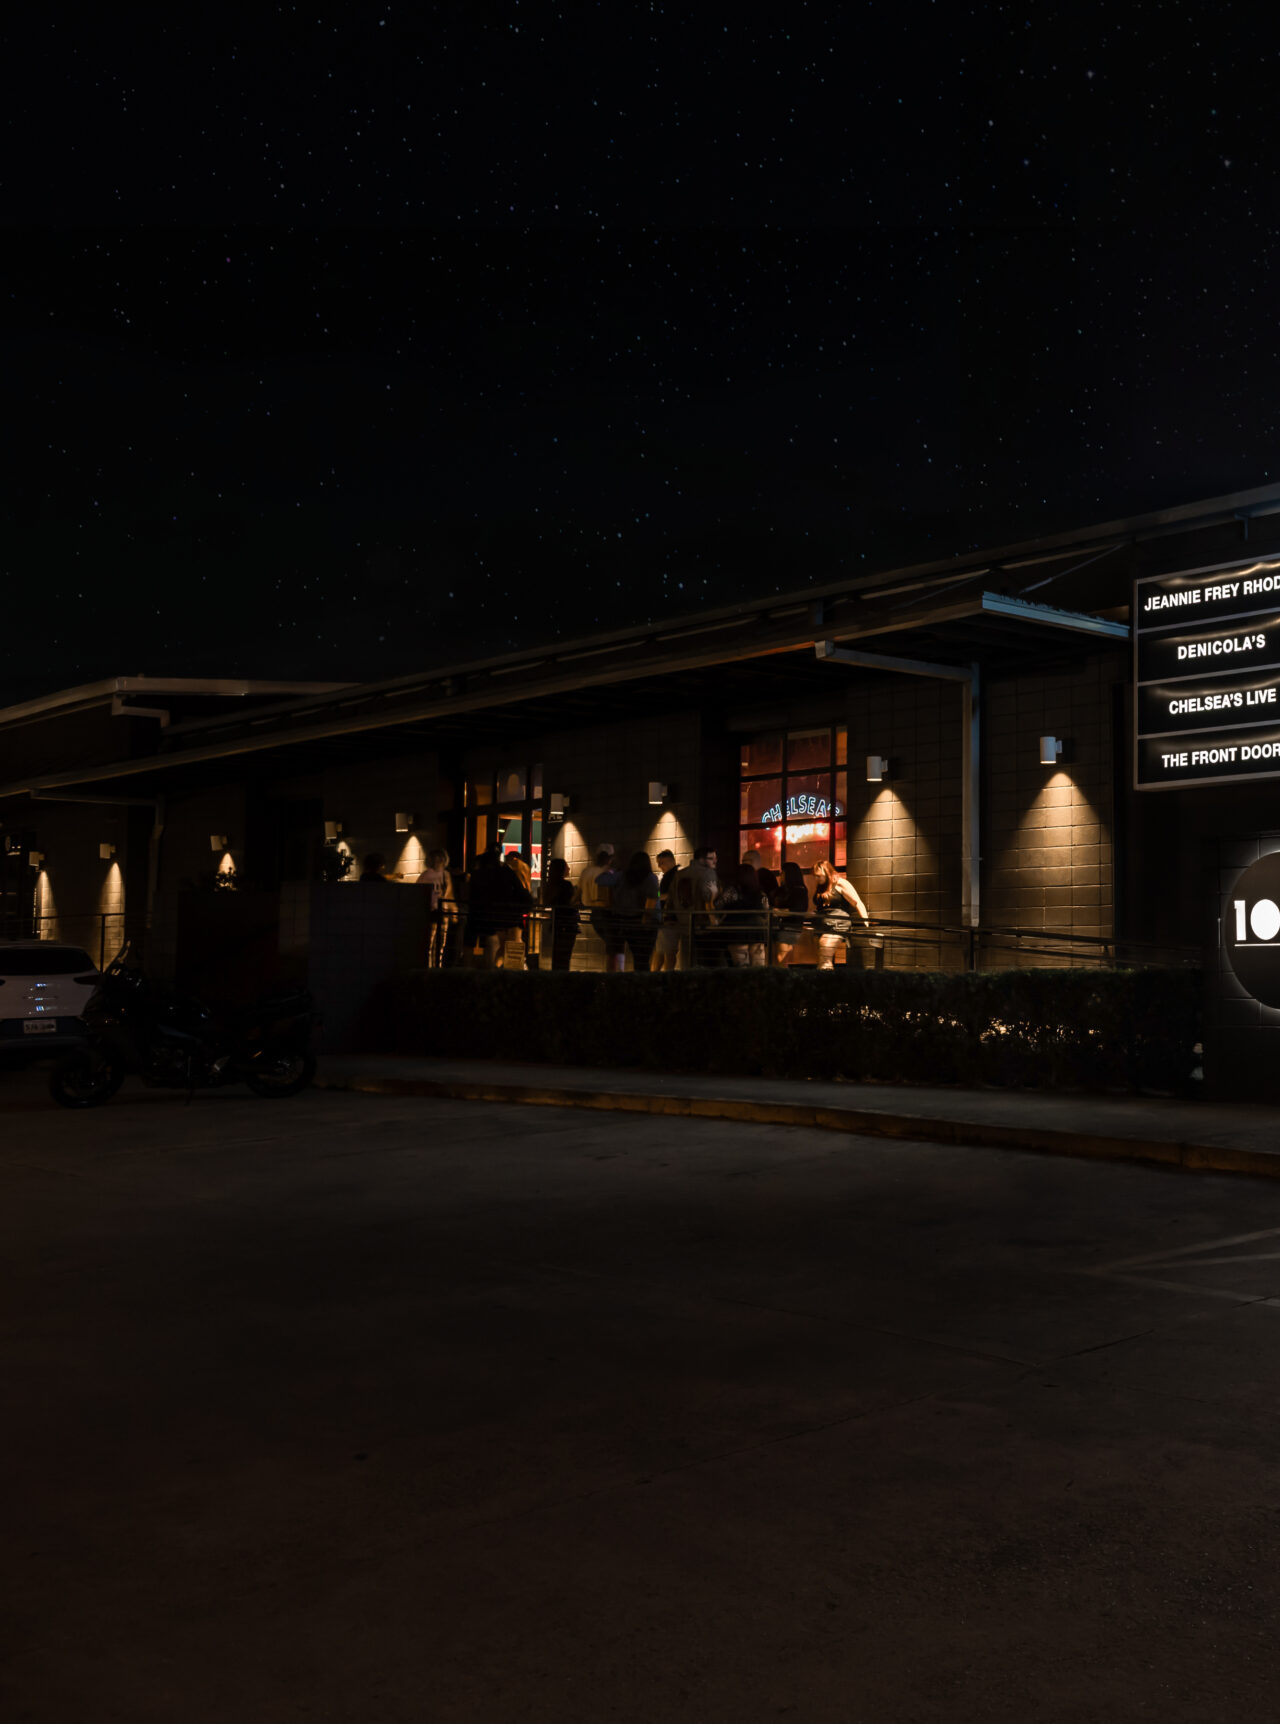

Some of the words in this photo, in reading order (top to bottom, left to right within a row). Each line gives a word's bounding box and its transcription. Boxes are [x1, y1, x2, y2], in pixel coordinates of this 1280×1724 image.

[1144, 589, 1201, 611] JEANNIE
[1204, 582, 1240, 602] FREY
[1177, 633, 1266, 660] DENICOLA'S
[1168, 692, 1243, 715] CHELSEA'S
[1246, 687, 1277, 706] LIVE
[1161, 752, 1188, 768] THE
[1191, 747, 1238, 766] FRONT
